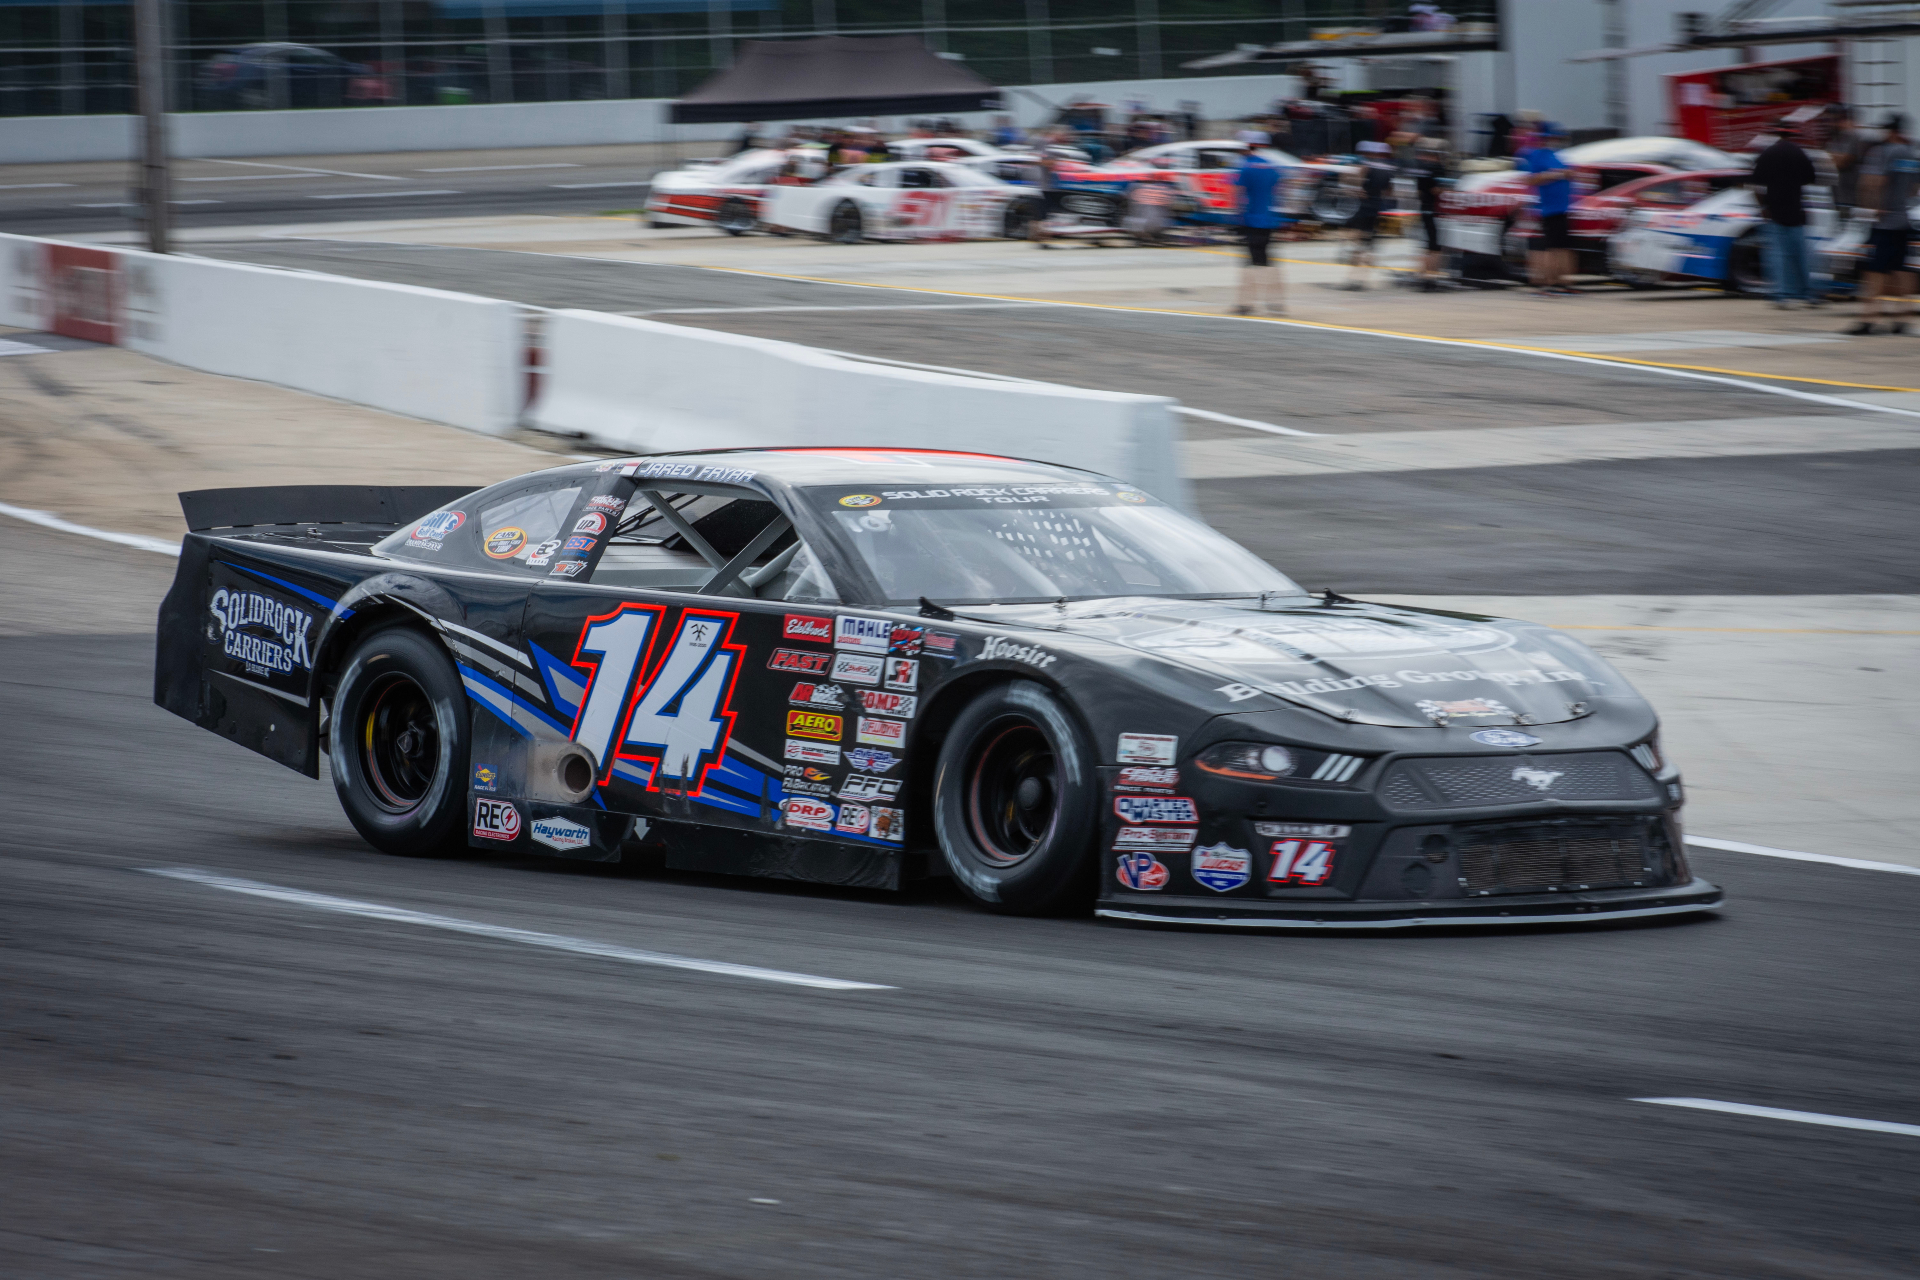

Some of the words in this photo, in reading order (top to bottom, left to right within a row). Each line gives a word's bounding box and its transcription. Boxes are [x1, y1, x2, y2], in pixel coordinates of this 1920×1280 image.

[638, 462, 698, 478] JARED
[882, 488, 951, 500] SOLID
[949, 487, 1014, 497] ROCK
[1013, 486, 1110, 496] CARRIERS
[975, 495, 1051, 504] TOUR
[420, 511, 458, 531] Bill's
[577, 519, 595, 531] UP
[566, 536, 595, 549] BST
[786, 618, 830, 638] Edelbrock
[842, 618, 890, 639] MAHLE
[224, 630, 293, 672] CARRIERS
[975, 635, 1057, 668] Hoosier
[773, 653, 830, 671] FAST
[571, 602, 747, 796] 14
[792, 714, 836, 732] AERO
[788, 803, 827, 816] DRP
[533, 823, 588, 839] Hayworth
[552, 835, 564, 844] Racing
[1118, 852, 1153, 889] VP
[1200, 858, 1248, 871] LUCAS
[1266, 838, 1337, 886] 14
